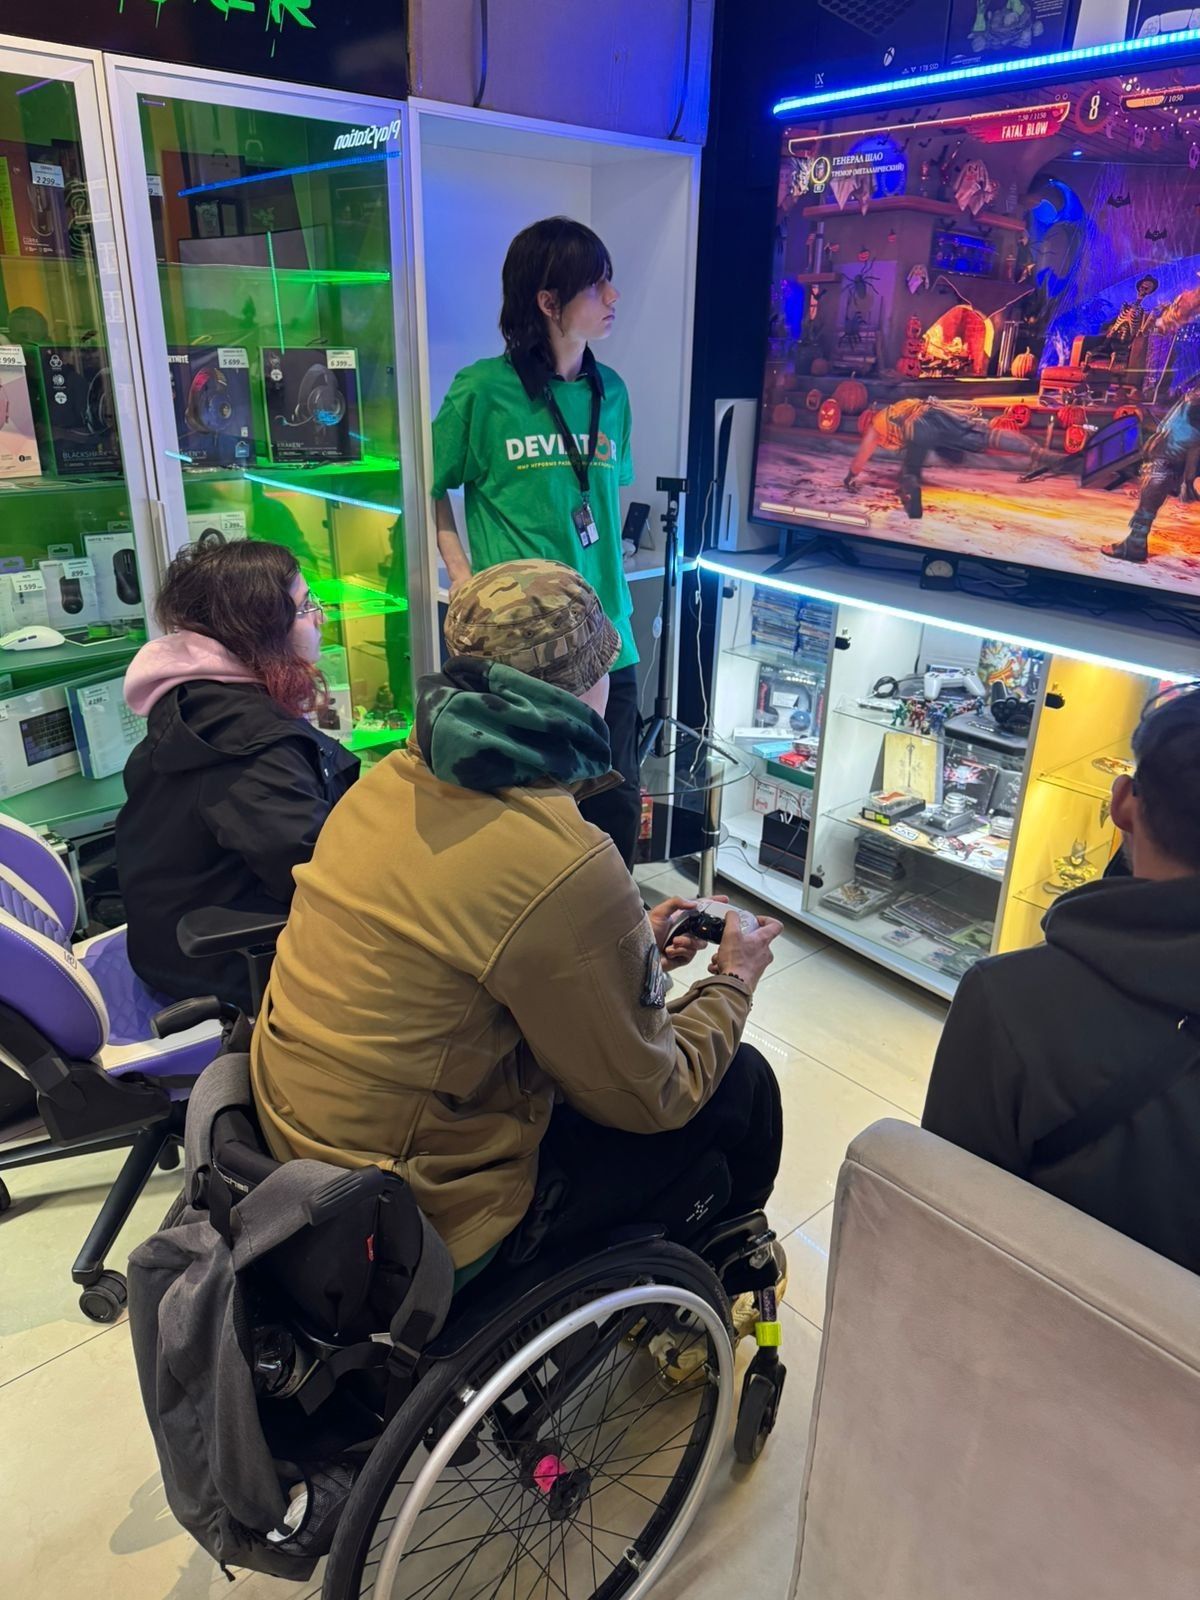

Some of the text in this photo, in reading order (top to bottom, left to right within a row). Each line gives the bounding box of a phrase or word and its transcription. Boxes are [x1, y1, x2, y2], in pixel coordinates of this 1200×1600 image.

[1088, 95, 1100, 120] 8
[1001, 121, 1049, 139] FATAL BLOW
[832, 151, 884, 166] ГЕНЕРАЛ ШАО
